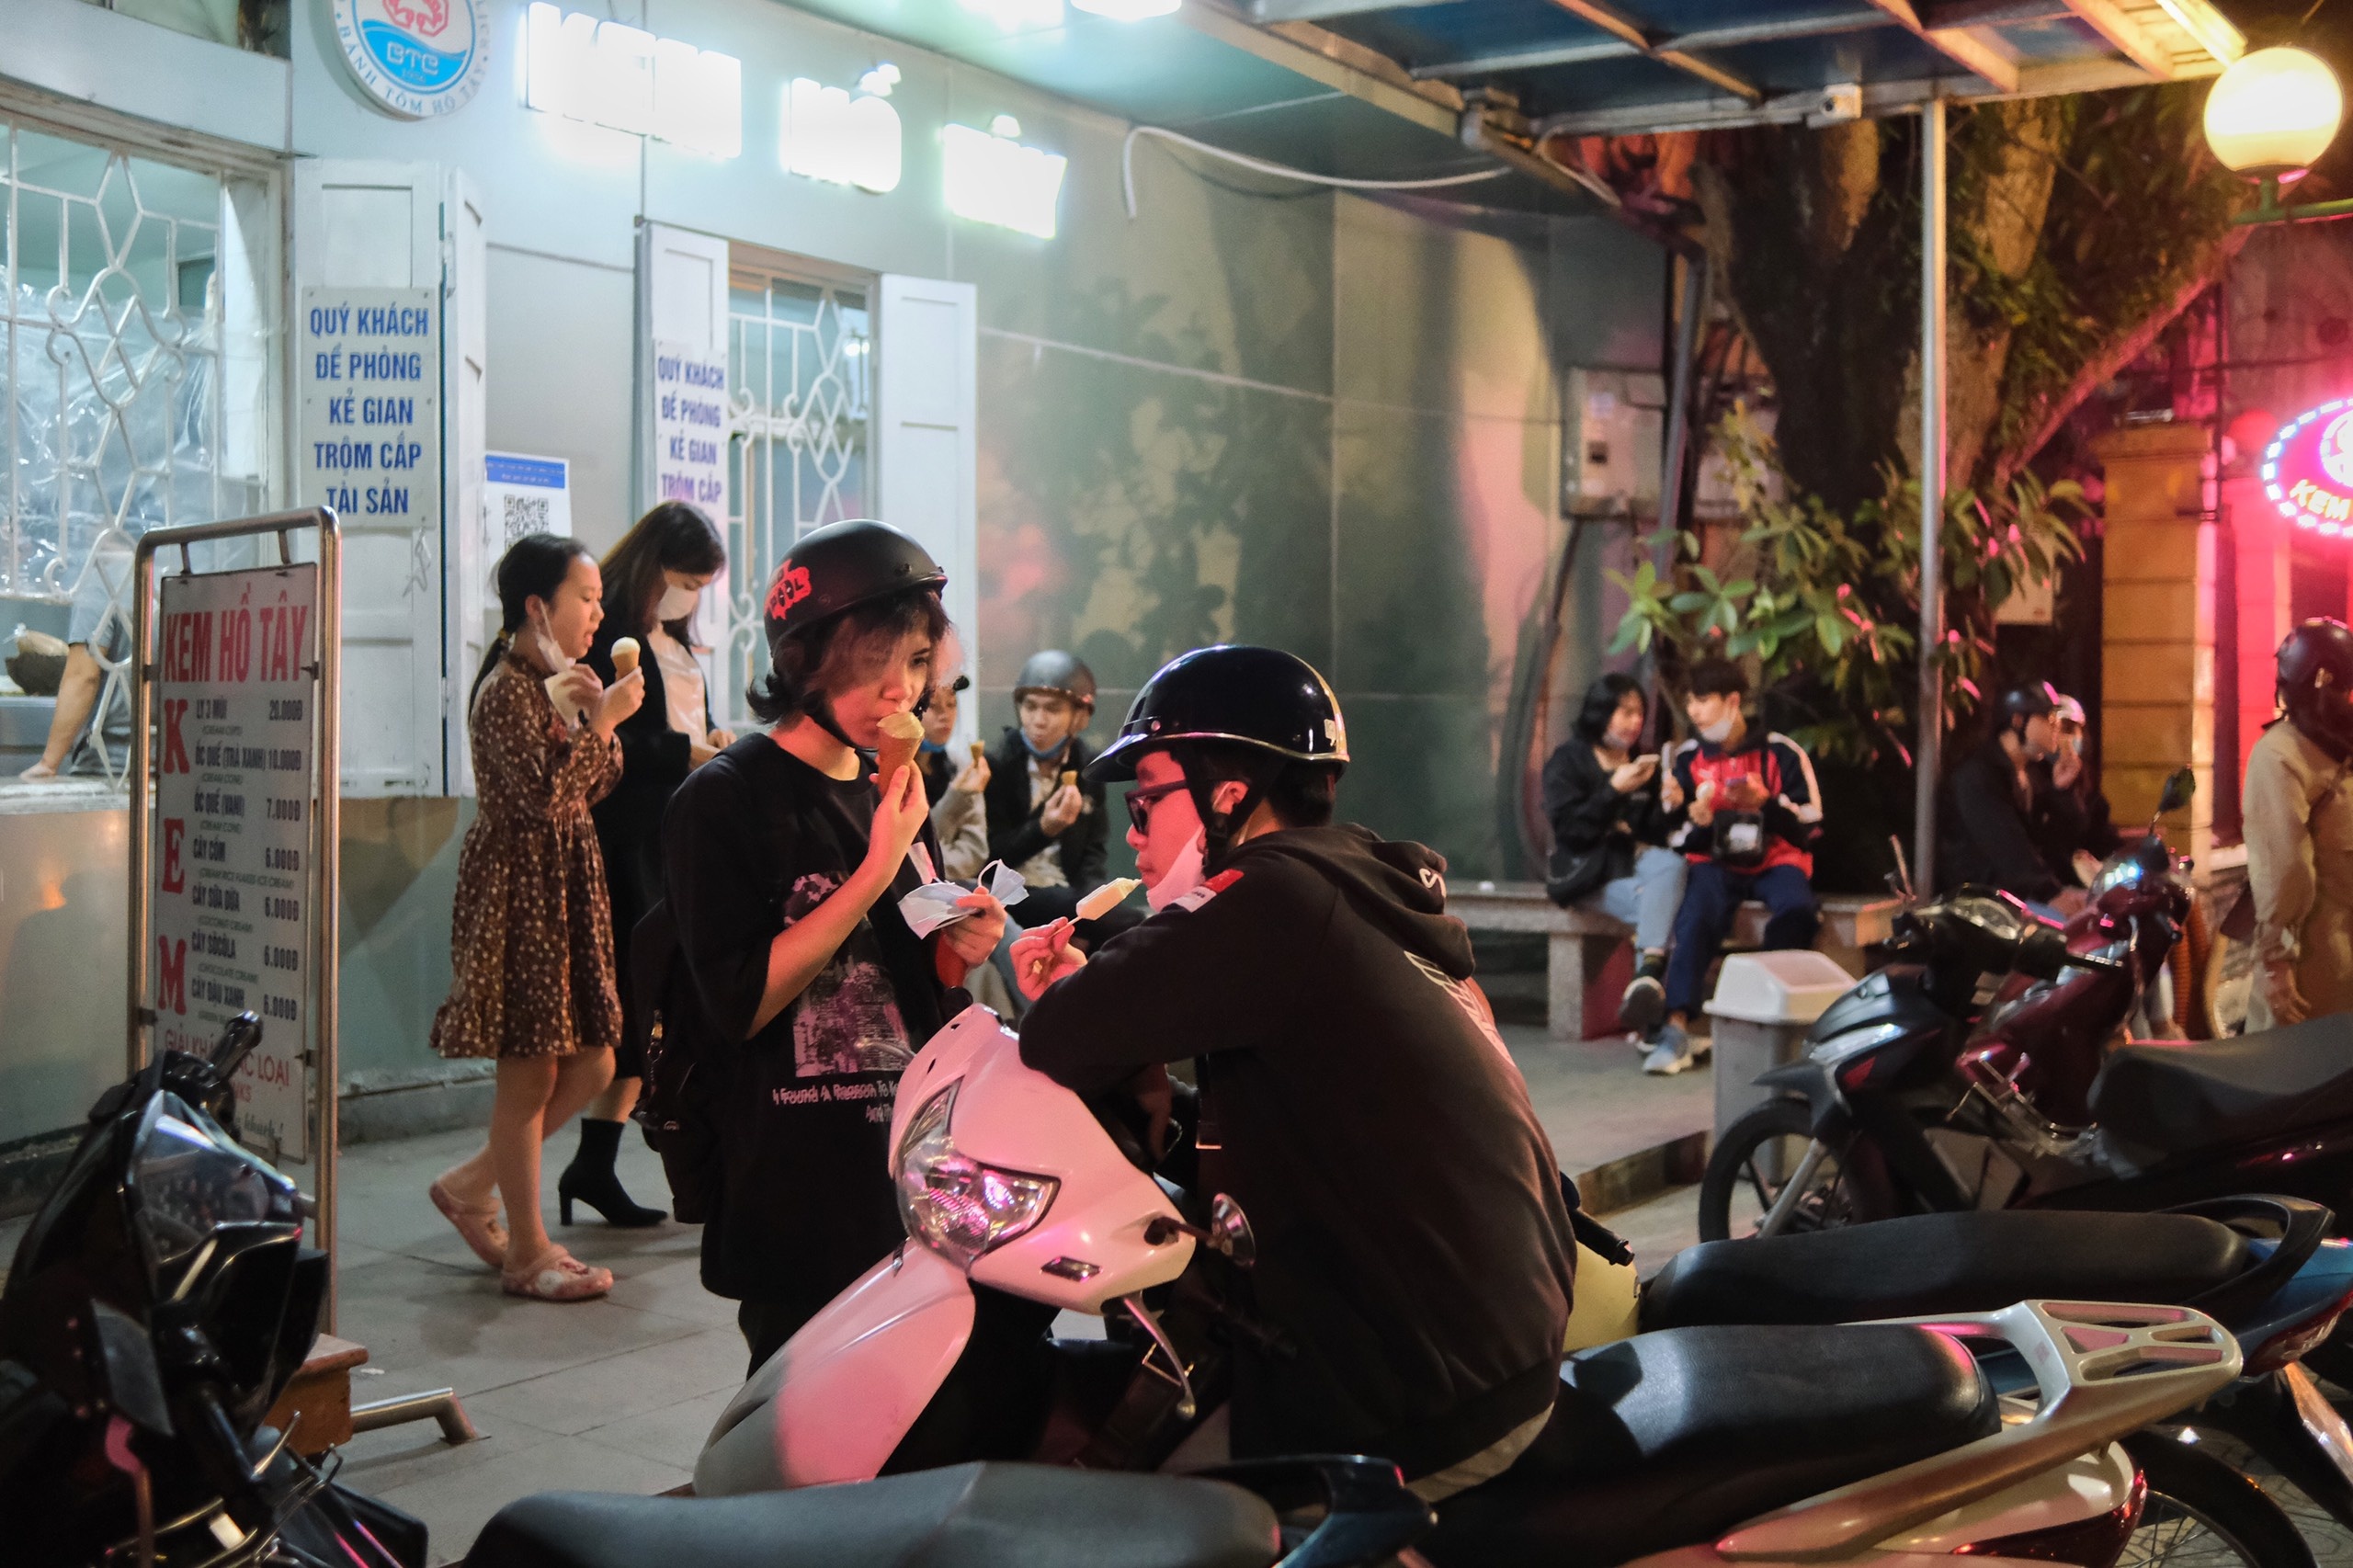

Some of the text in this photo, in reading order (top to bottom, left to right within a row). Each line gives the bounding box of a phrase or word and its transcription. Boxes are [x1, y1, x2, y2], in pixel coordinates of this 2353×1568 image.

[310, 301, 429, 338] QUÝ KHÁCH
[349, 345, 422, 381] PHÒNG
[658, 354, 724, 390] QUÝ KHÁCH
[329, 388, 414, 425] KẺ GIAN
[313, 435, 372, 476] TRỘM
[688, 439, 717, 465] GIAN
[326, 477, 408, 515] TÀI SẢN
[2289, 479, 2352, 521] KEM
[164, 610, 213, 683] KEM
[259, 589, 308, 682] TÂY
[192, 1033, 214, 1055] KHÁ
[257, 1056, 290, 1091] LOẠI
[780, 1085, 819, 1105] Found
[820, 1084, 832, 1101] A
[833, 1083, 877, 1101] Reason
